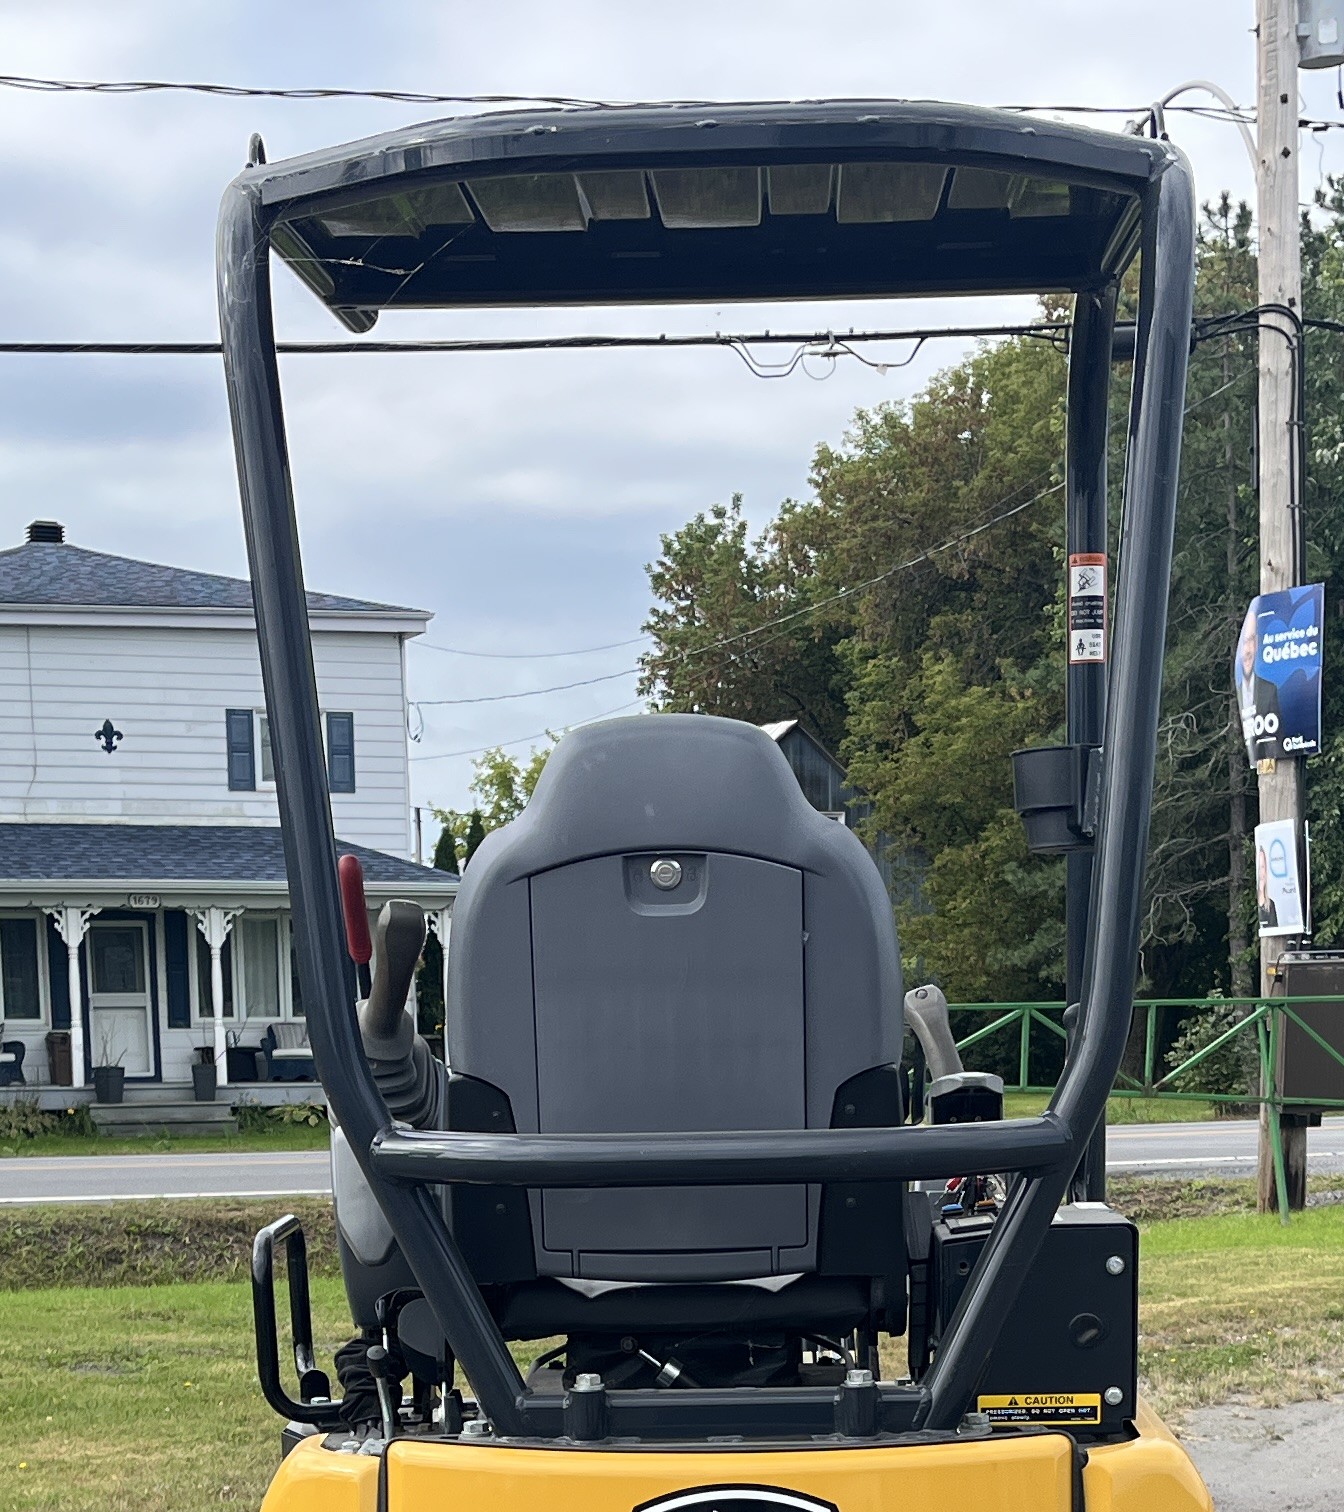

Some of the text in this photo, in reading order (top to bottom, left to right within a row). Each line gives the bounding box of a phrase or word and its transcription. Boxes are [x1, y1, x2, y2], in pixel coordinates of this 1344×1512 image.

[1263, 625, 1319, 645] Au service du
[1263, 640, 1318, 664] Québec
[1024, 1395, 1074, 1406] CAUTION
